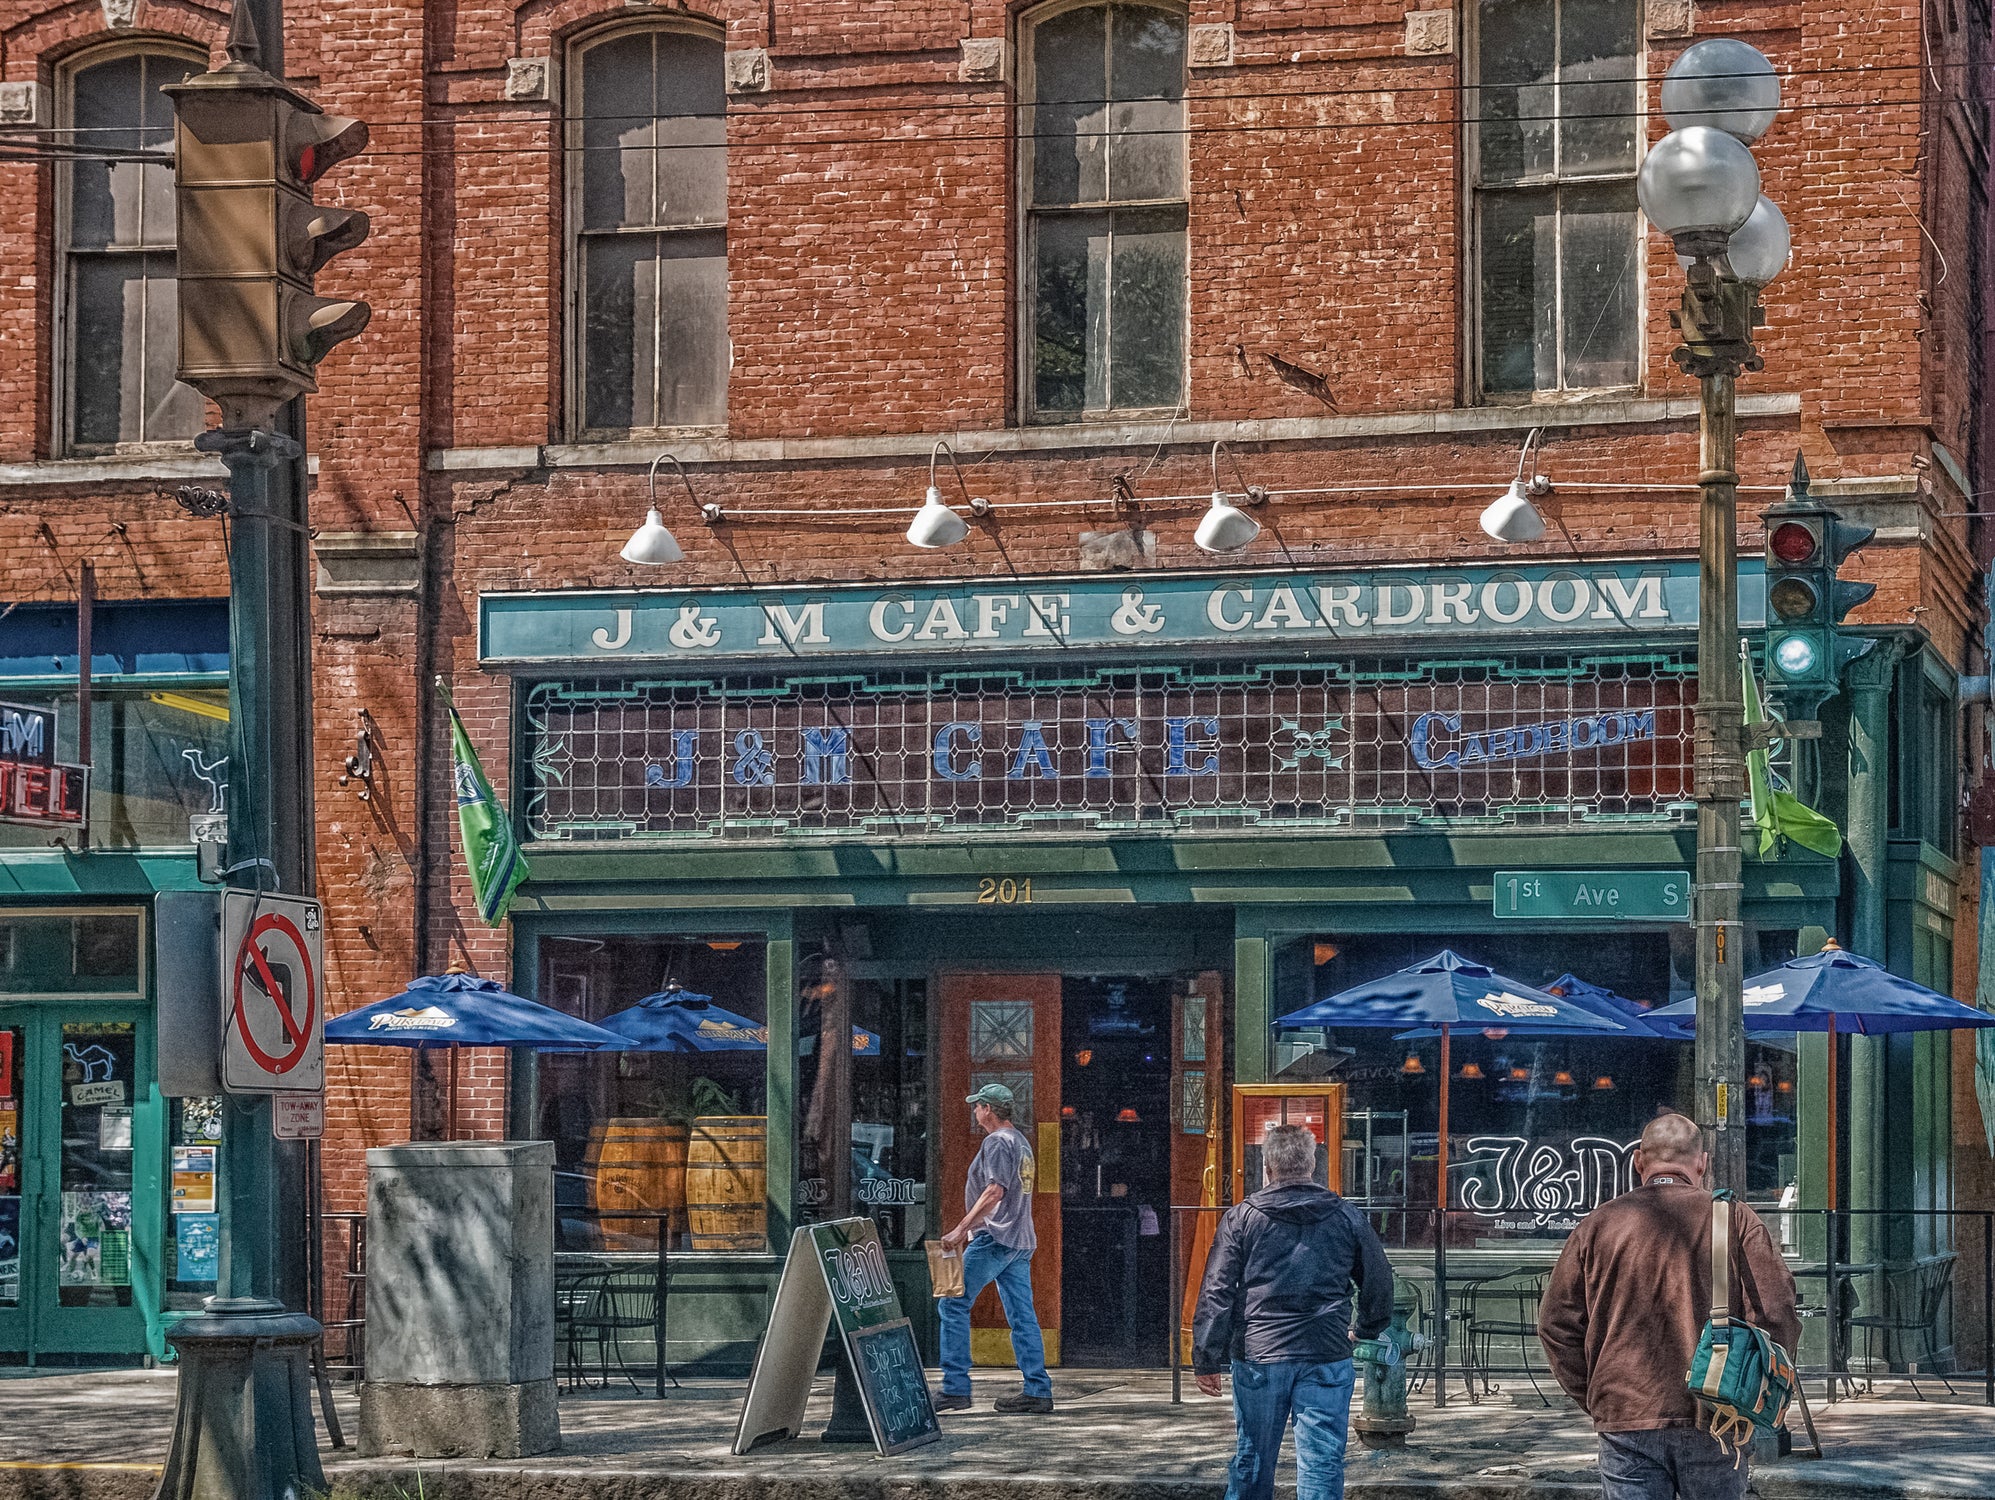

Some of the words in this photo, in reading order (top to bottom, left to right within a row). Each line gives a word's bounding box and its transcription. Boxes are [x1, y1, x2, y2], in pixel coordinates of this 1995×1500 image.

[591, 604, 637, 650] J
[669, 601, 722, 648] &
[756, 599, 831, 645] M
[869, 590, 1071, 643] CAFE
[1110, 586, 1166, 635] &
[1205, 573, 1670, 633] CARDROOM
[647, 730, 696, 787] J
[733, 729, 776, 786] &
[801, 728, 853, 785] M
[978, 877, 1032, 903] 201
[1506, 878, 1541, 911] 1st
[1573, 884, 1619, 906] Ave
[1662, 883, 1679, 905] S
[77, 1086, 120, 1101] CAMEL
[280, 1101, 318, 1111] TOW-AWAY
[290, 1113, 310, 1123] ZONE
[859, 1178, 917, 1202] J&M
[1494, 1219, 1516, 1230] Live
[1516, 1219, 1537, 1230] and
[824, 1240, 893, 1305] J&M
[881, 1394, 921, 1432] Lunch
